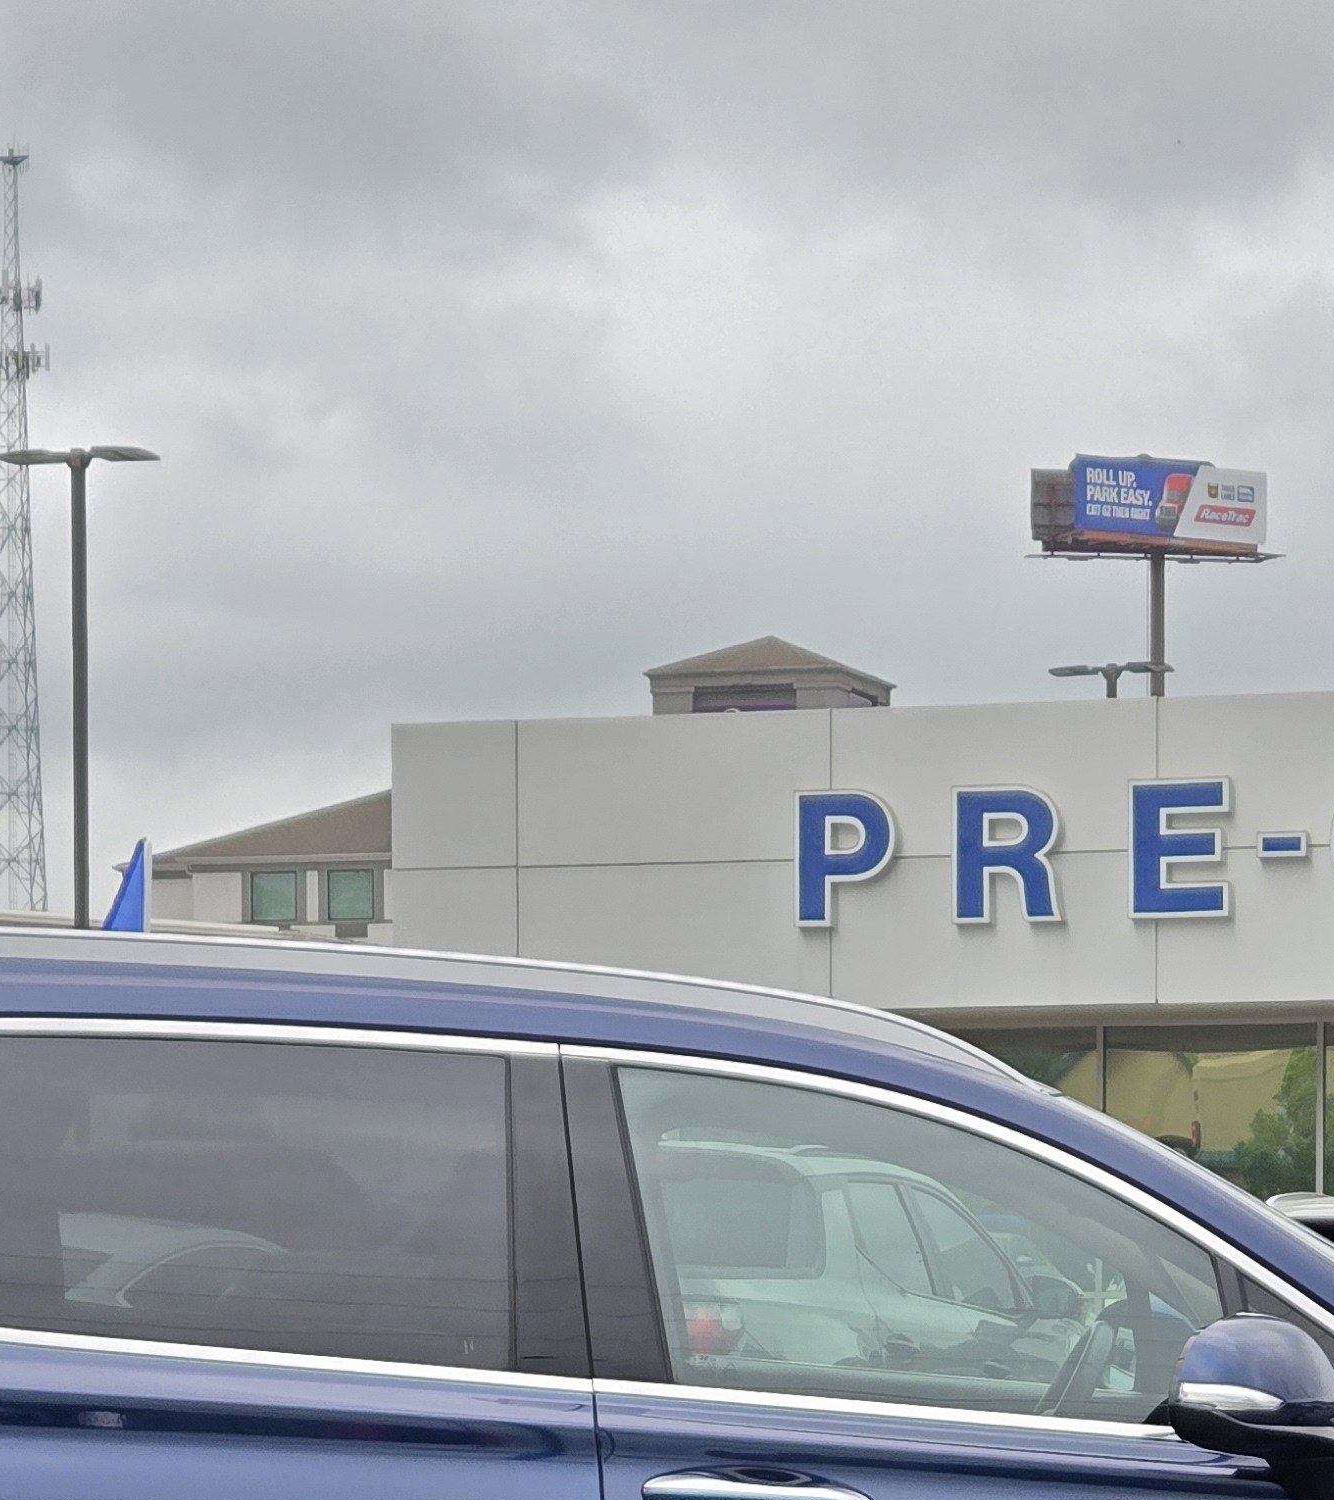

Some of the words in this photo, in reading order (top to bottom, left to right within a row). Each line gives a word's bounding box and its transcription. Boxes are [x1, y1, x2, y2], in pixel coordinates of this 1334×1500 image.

[1086, 467, 1117, 485] ROLL
[1118, 470, 1137, 488] UP.
[1086, 485, 1119, 503] PARK
[1120, 487, 1153, 507] EASY.
[1200, 508, 1250, 524] RaceTrac
